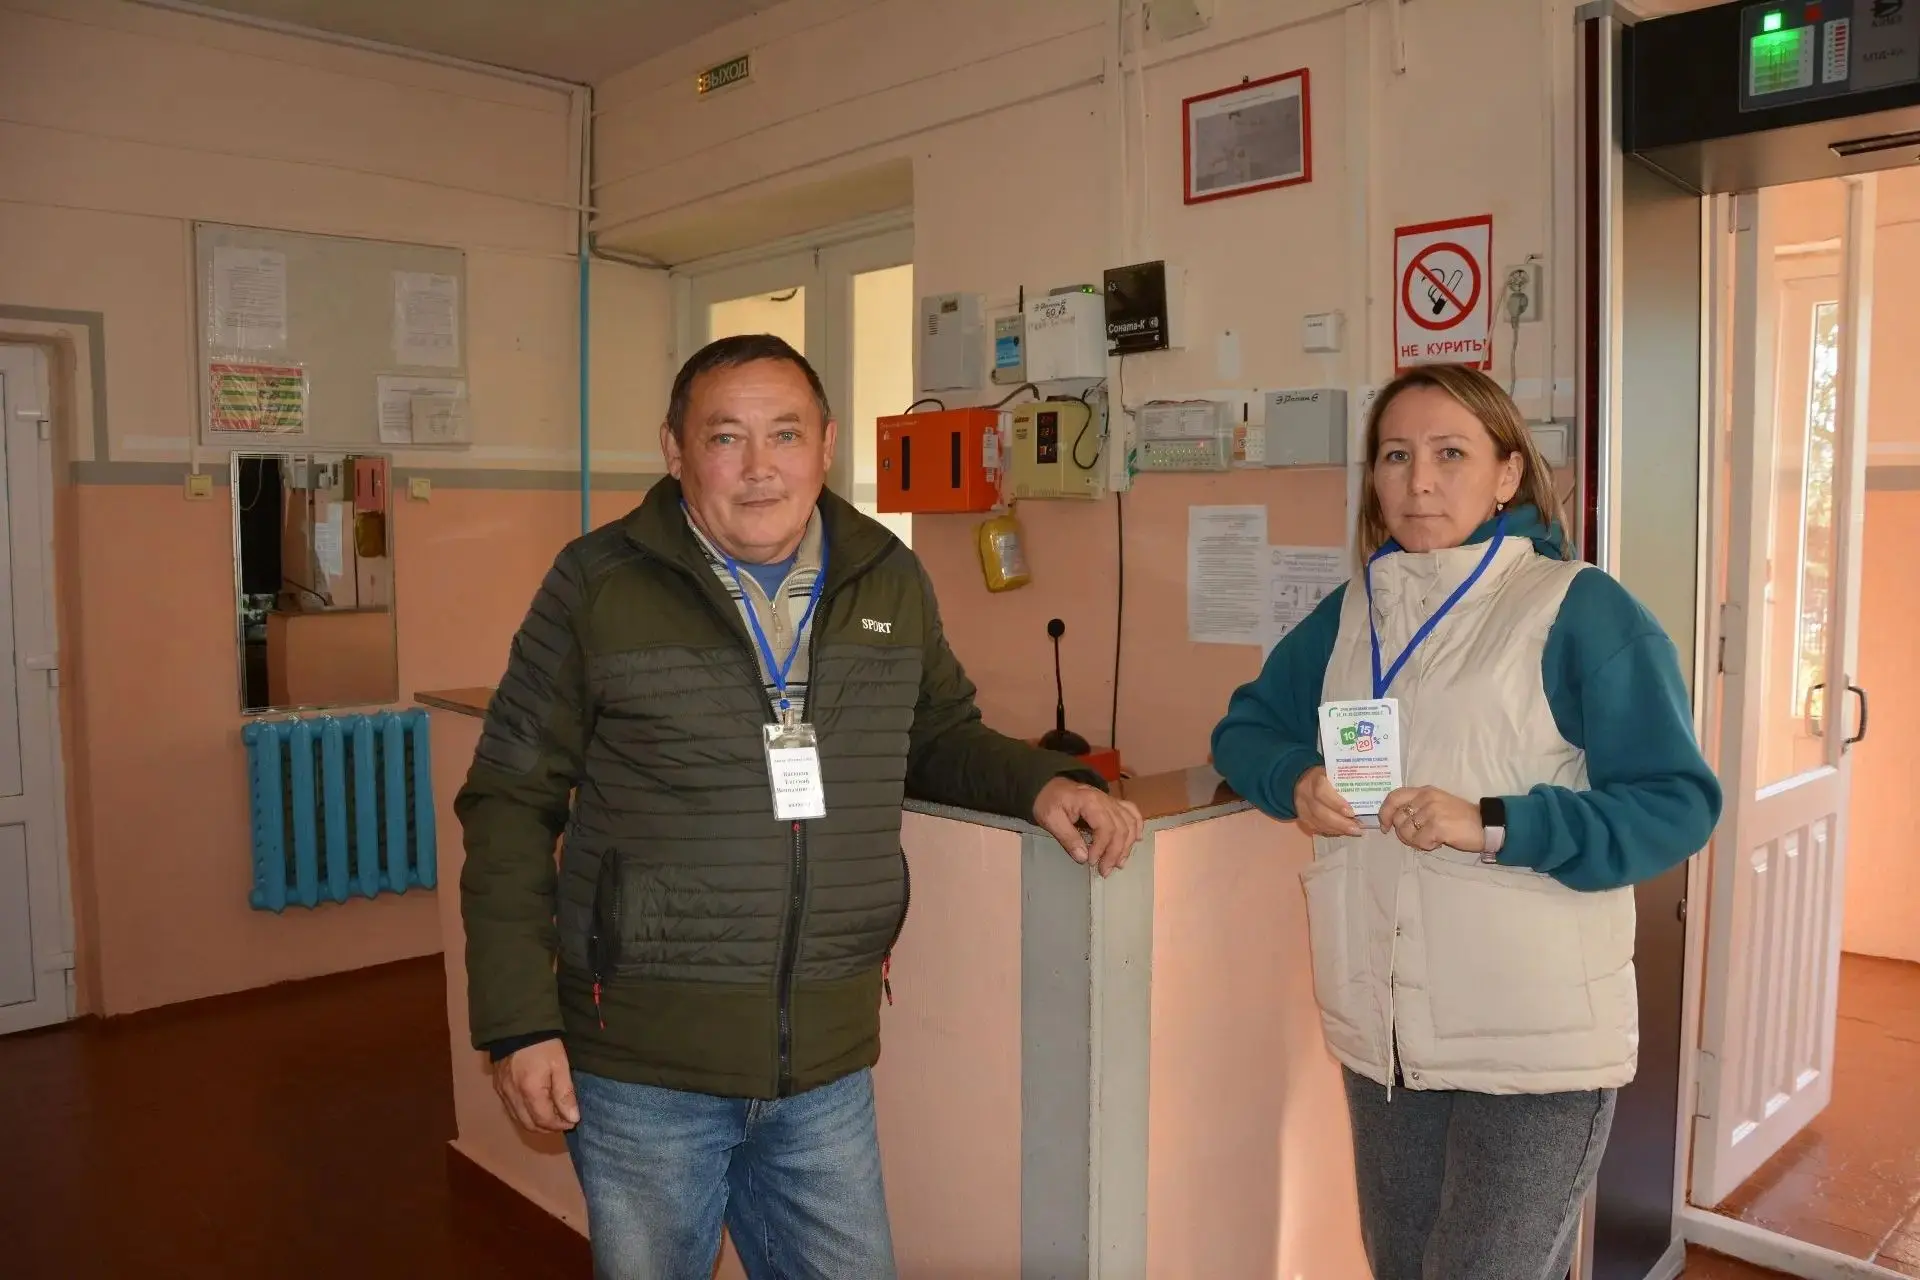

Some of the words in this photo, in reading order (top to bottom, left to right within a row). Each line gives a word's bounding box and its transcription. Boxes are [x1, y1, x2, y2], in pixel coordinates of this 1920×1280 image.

[703, 59, 748, 90] ВЫХОД
[1401, 344, 1419, 357] НЕ
[861, 618, 892, 634] SPORT
[1359, 725, 1371, 734] 15
[1344, 731, 1355, 741] 10
[1358, 739, 1370, 748] 20
